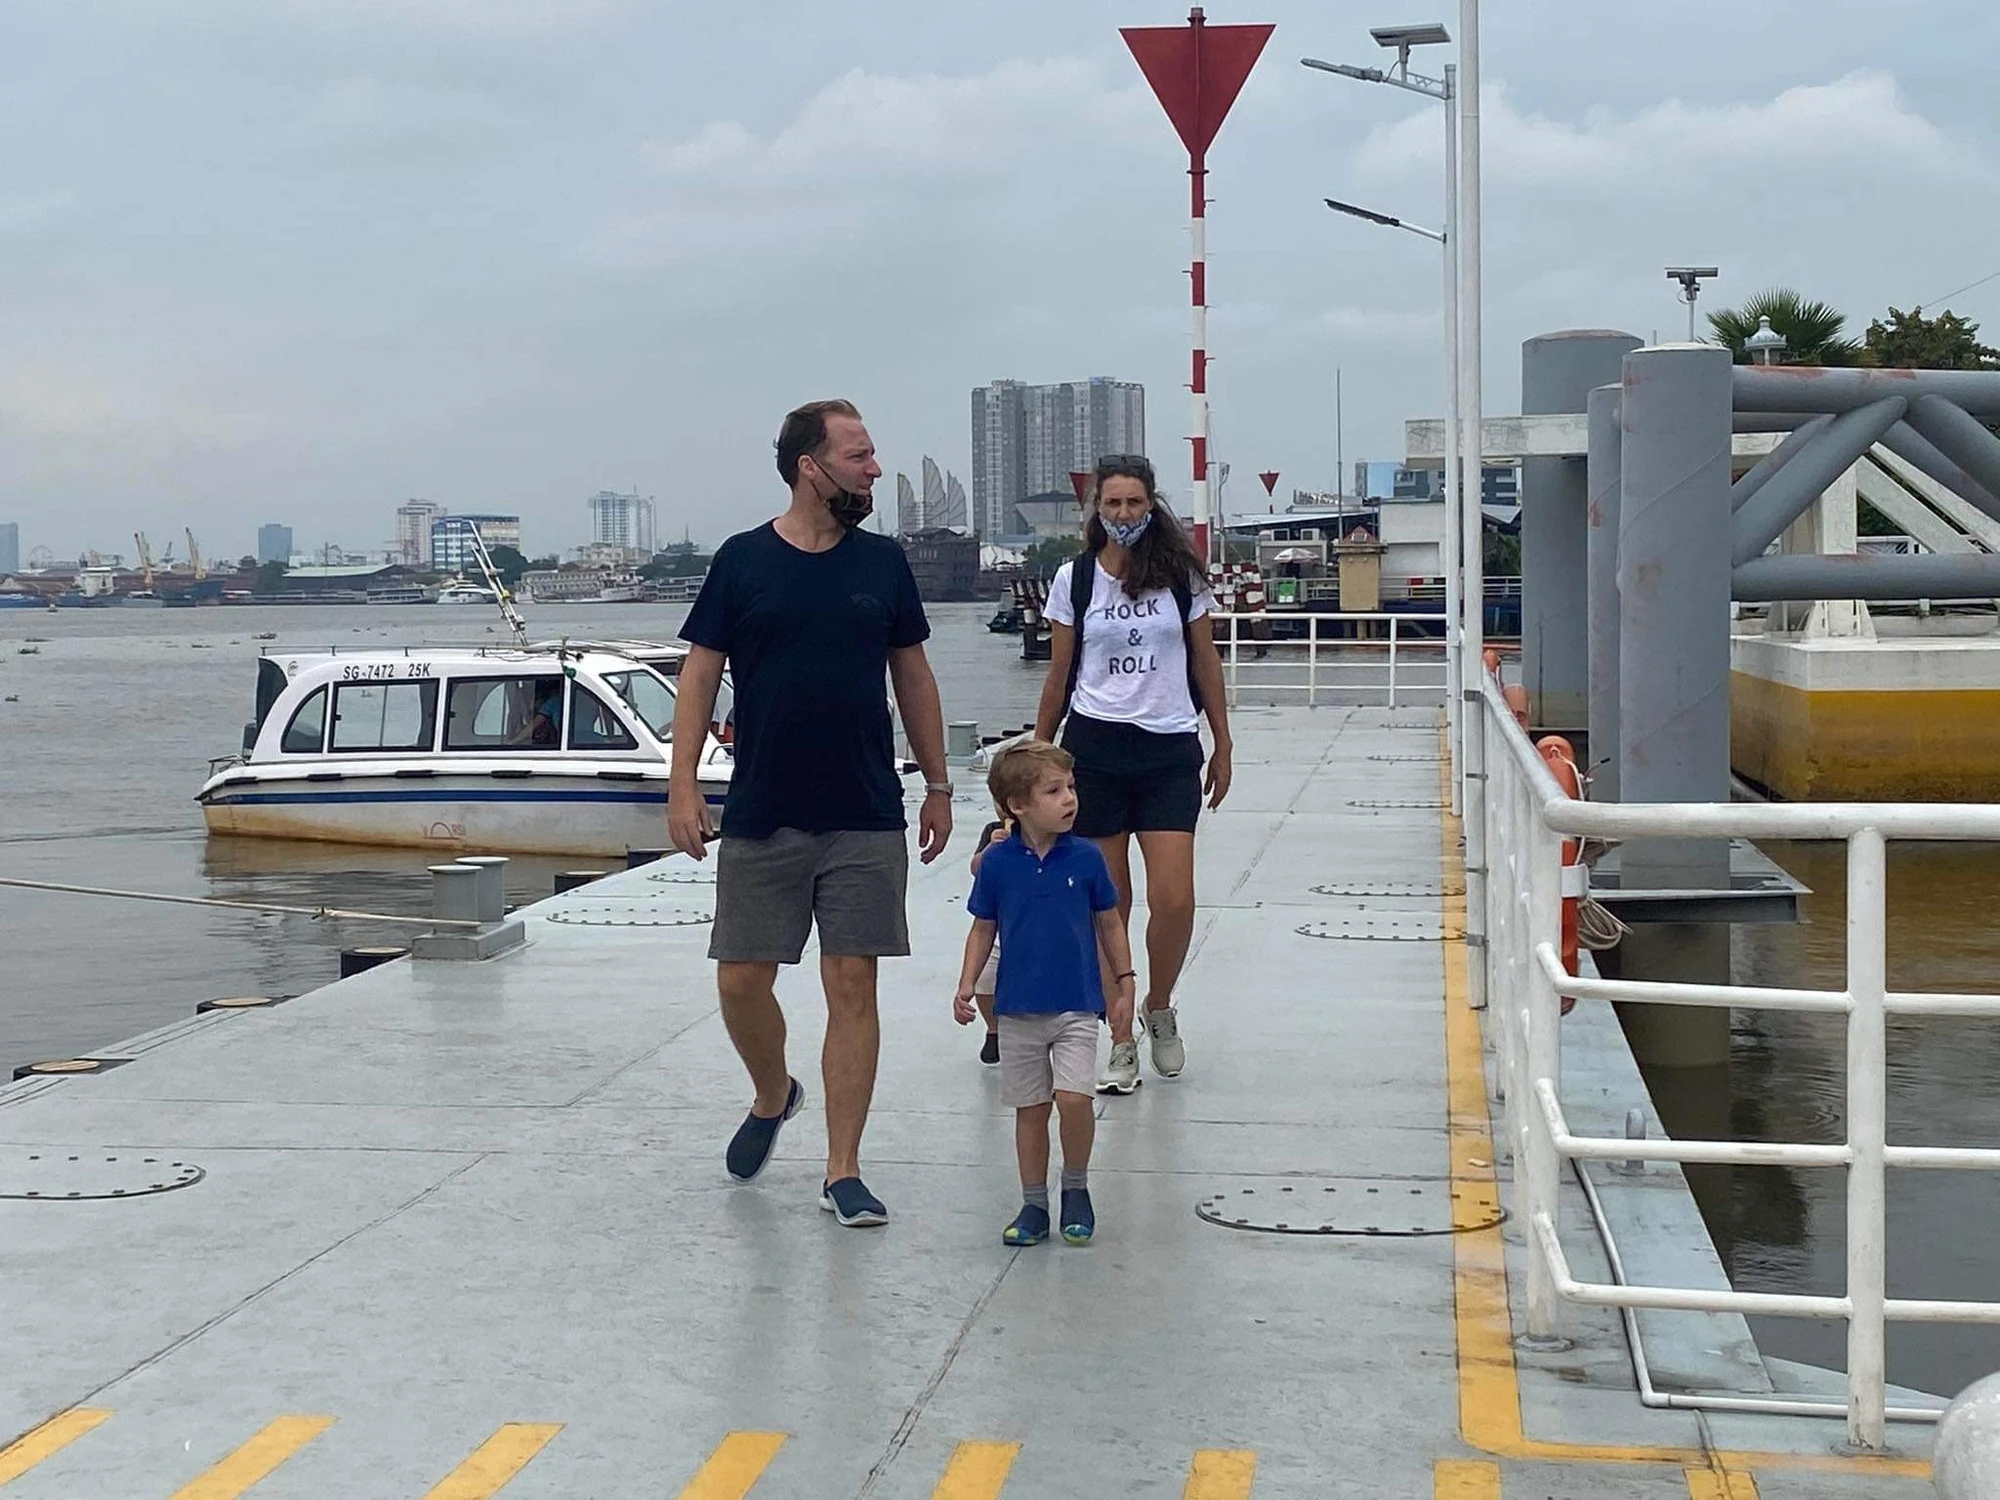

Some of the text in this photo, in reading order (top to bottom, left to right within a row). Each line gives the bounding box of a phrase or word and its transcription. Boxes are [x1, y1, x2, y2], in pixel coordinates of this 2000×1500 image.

[1104, 598, 1161, 621] ROCK
[1127, 628, 1143, 647] &
[408, 663, 431, 677] 25K
[1109, 654, 1157, 675] ROLL
